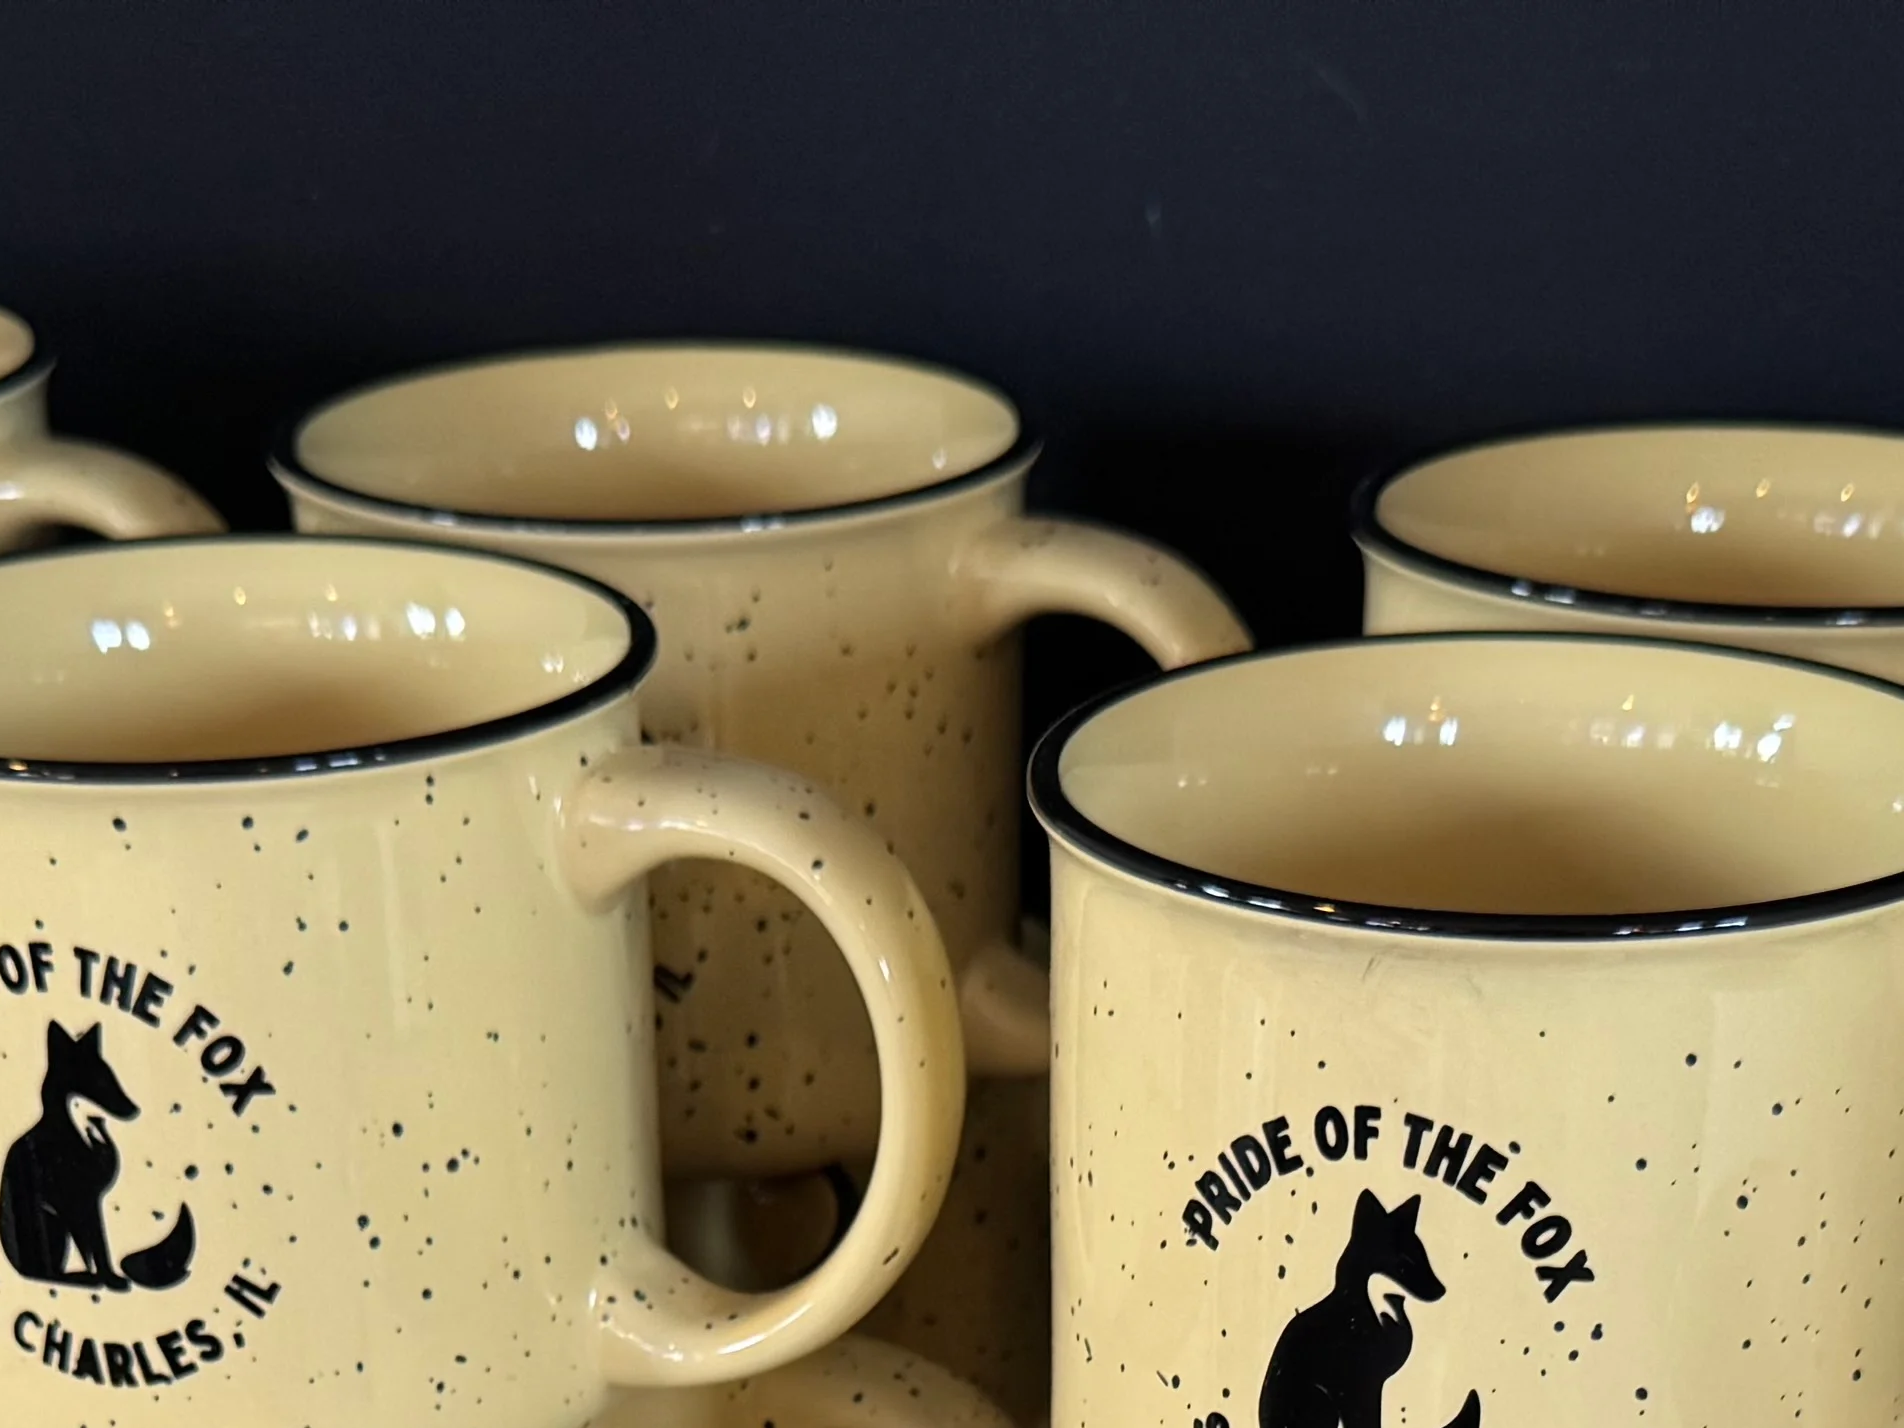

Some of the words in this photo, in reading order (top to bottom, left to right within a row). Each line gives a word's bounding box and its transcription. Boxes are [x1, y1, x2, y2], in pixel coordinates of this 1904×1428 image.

[73, 946, 174, 1028] THE
[173, 1004, 276, 1117] FOX
[1183, 1116, 1303, 1251] PRIDE
[1314, 1105, 1381, 1161] OF
[1403, 1112, 1509, 1205] THE
[1497, 1181, 1594, 1303] FOX
[224, 1274, 282, 1319] IL
